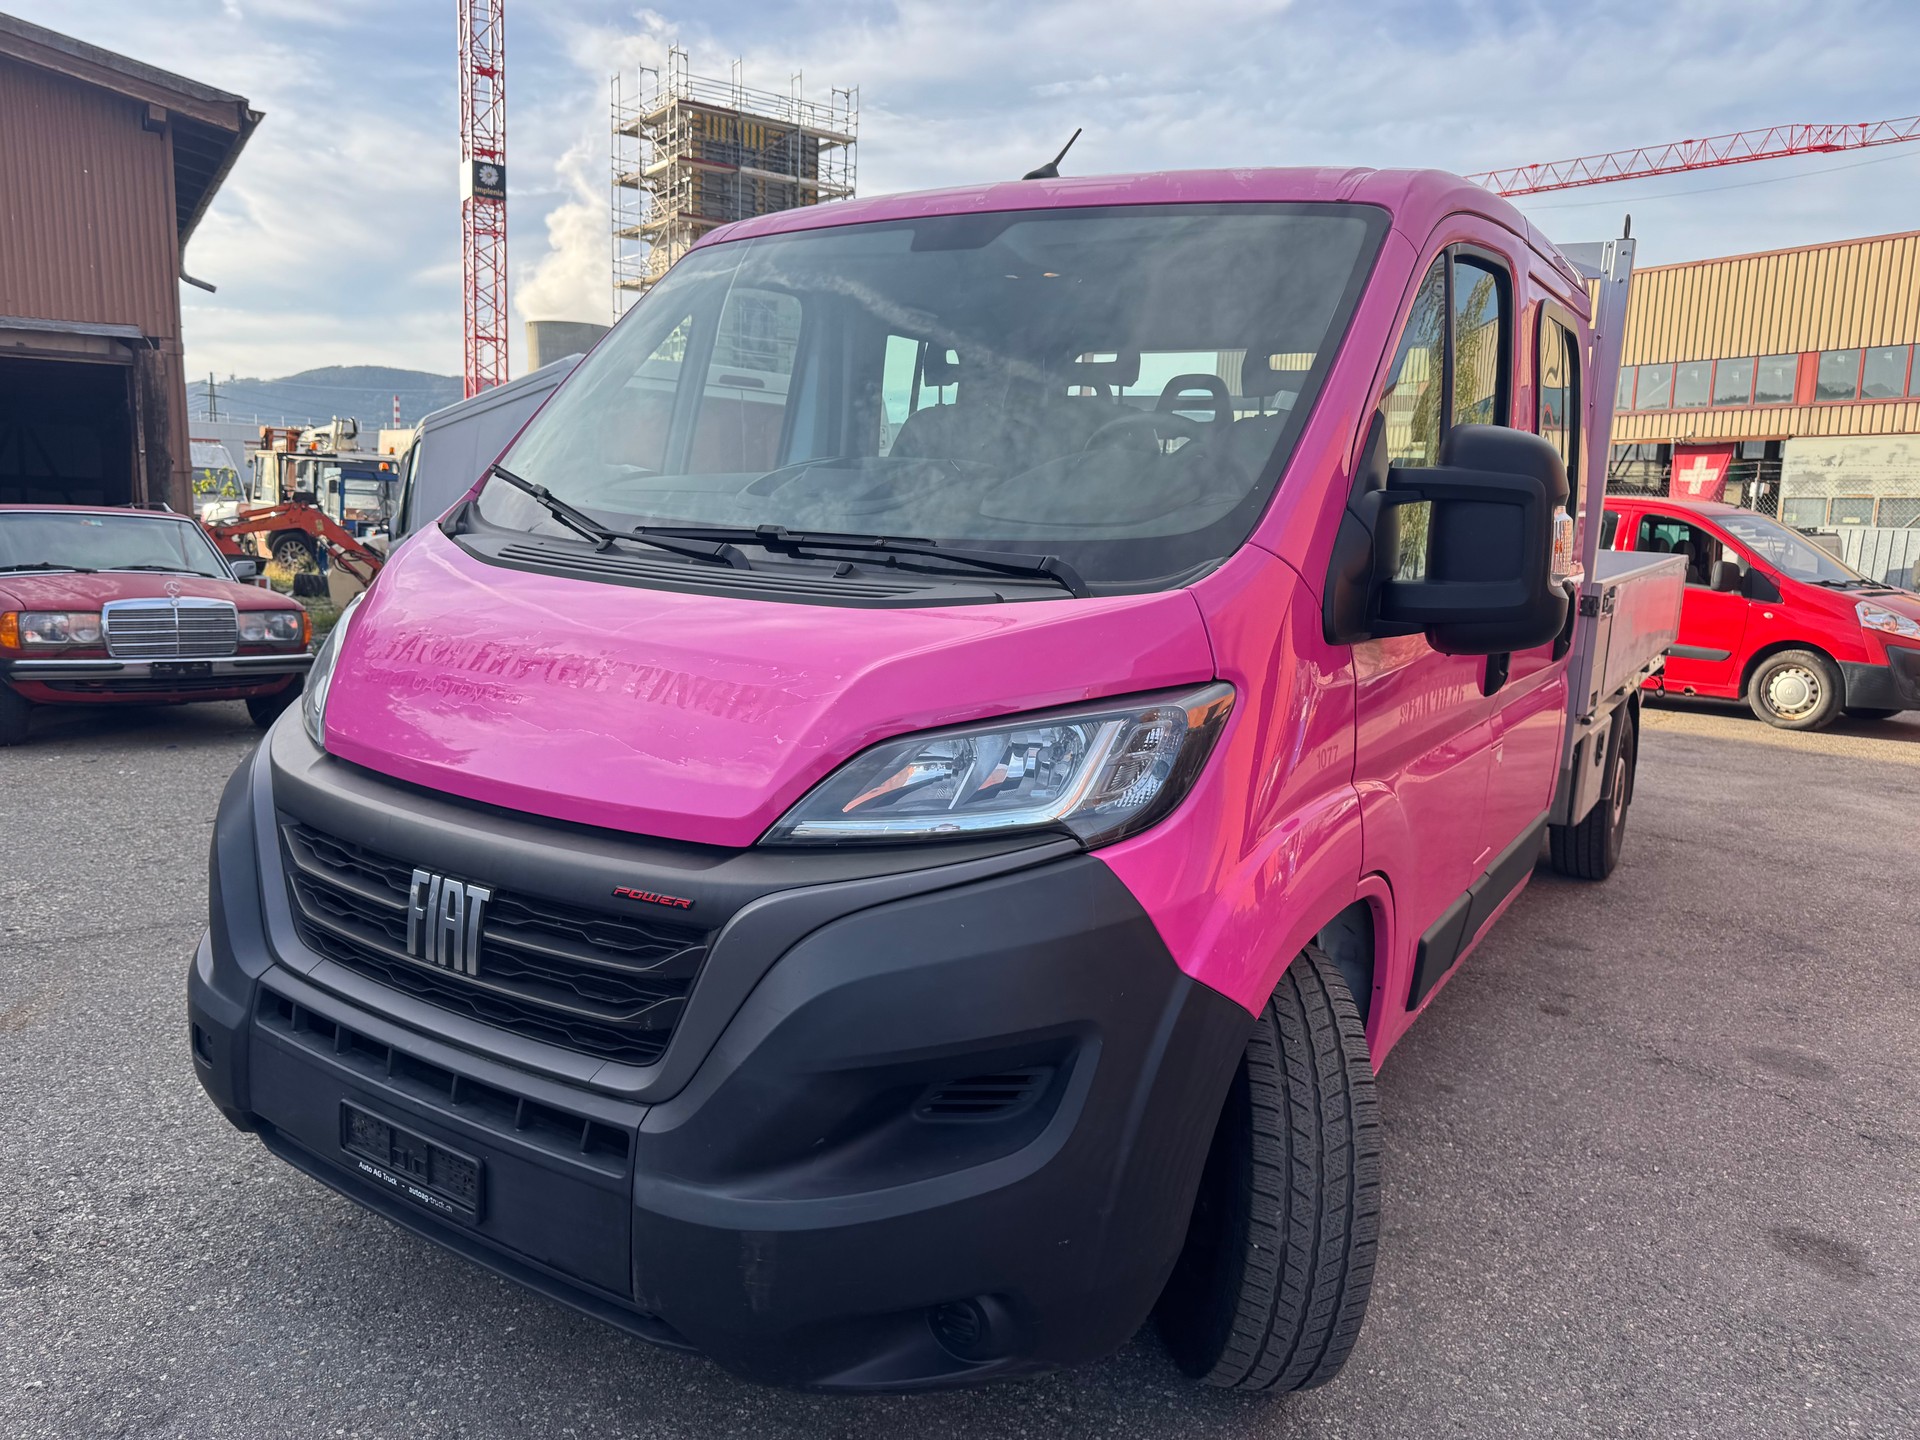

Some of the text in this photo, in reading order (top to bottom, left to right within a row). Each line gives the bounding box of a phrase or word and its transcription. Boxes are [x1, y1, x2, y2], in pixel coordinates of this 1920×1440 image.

[474, 185, 504, 197] Implenia
[1316, 744, 1339, 770] 1077
[613, 886, 692, 909] POWER
[406, 868, 492, 976] FIAT
[358, 1161, 373, 1174] Auto
[373, 1168, 382, 1178] AG
[383, 1172, 398, 1186] Truck
